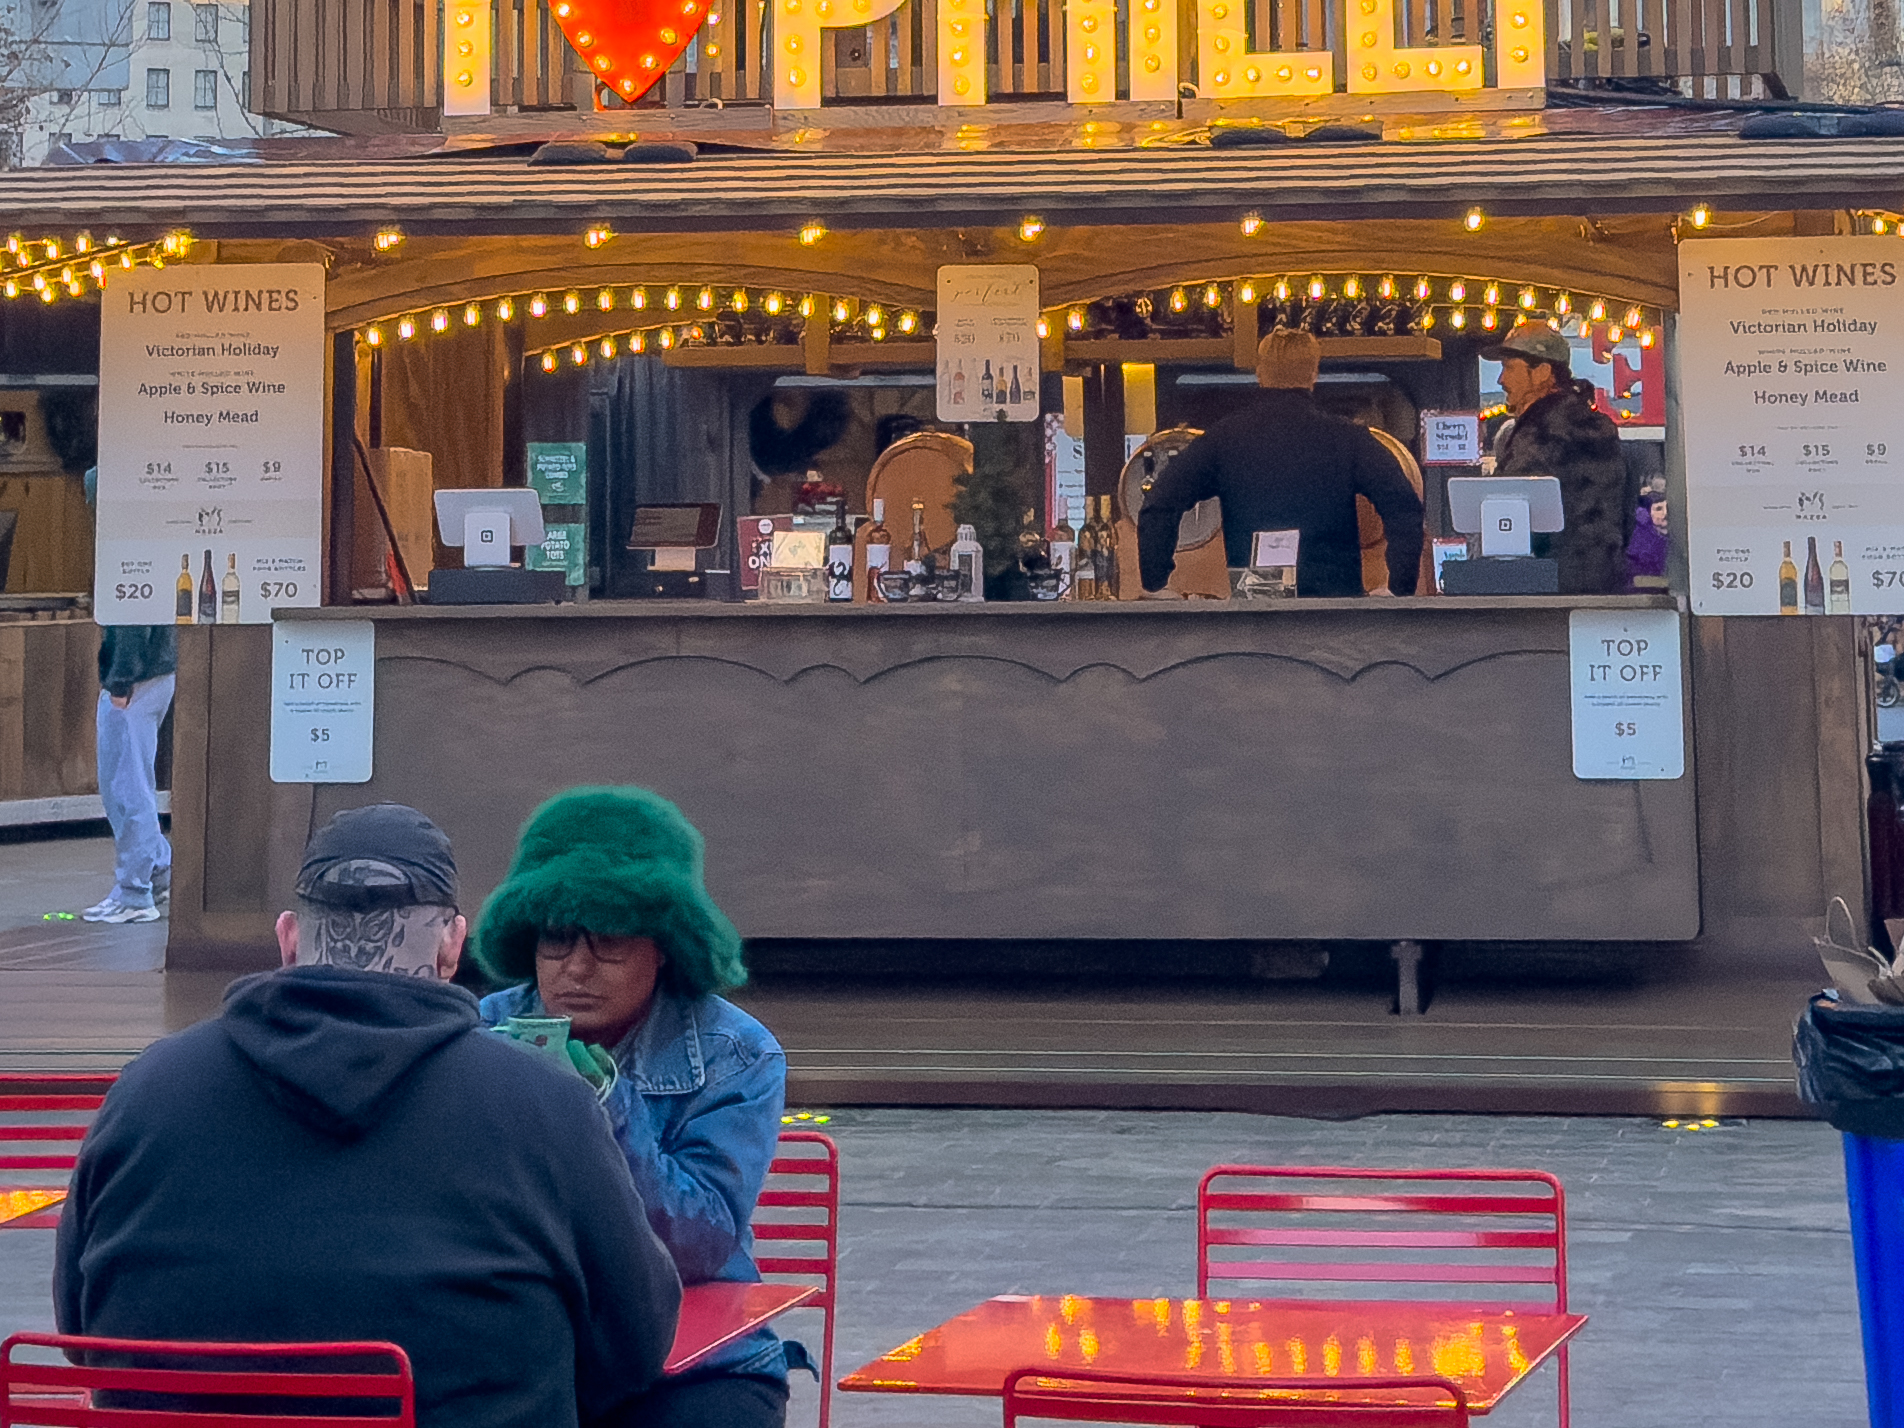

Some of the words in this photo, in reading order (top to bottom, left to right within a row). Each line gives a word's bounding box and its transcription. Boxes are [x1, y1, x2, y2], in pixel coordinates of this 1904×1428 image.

[1707, 265, 1778, 289] HOT
[1788, 262, 1897, 287] WINES
[128, 291, 193, 314] HOT
[202, 289, 300, 313] WINES
[1729, 320, 1808, 335] Victorian
[1813, 318, 1878, 335] Holiday
[145, 344, 216, 358] Victorian
[221, 342, 280, 358] Holiday
[1724, 359, 1773, 377] Apple
[1777, 360, 1788, 373] &
[1793, 359, 1839, 376] Spice
[1842, 358, 1887, 373] Wine
[137, 382, 182, 398] Apple
[186, 382, 196, 395] &
[200, 382, 242, 397] Spice
[246, 381, 286, 394] Wine
[1754, 390, 1808, 406] Honey
[1814, 389, 1860, 404] Mead
[163, 410, 213, 427] Honey
[217, 410, 259, 424] Mead
[1435, 421, 1467, 433] Cherry
[1738, 445, 1767, 458] $14
[1802, 444, 1831, 457] $15
[1866, 443, 1887, 457] $9
[146, 461, 172, 475] $14
[204, 461, 230, 474] $15
[540, 540, 571, 551] POTATO
[1711, 572, 1754, 590] $20
[115, 583, 154, 601] $20
[260, 581, 298, 599] $70
[301, 648, 345, 665] TOP
[1601, 639, 1649, 657] TOP
[289, 673, 310, 689] IT
[317, 673, 358, 689] OFF
[1589, 664, 1611, 682] IT
[1619, 664, 1663, 682] OFF
[310, 727, 330, 742] $5
[1615, 721, 1637, 737] $5
